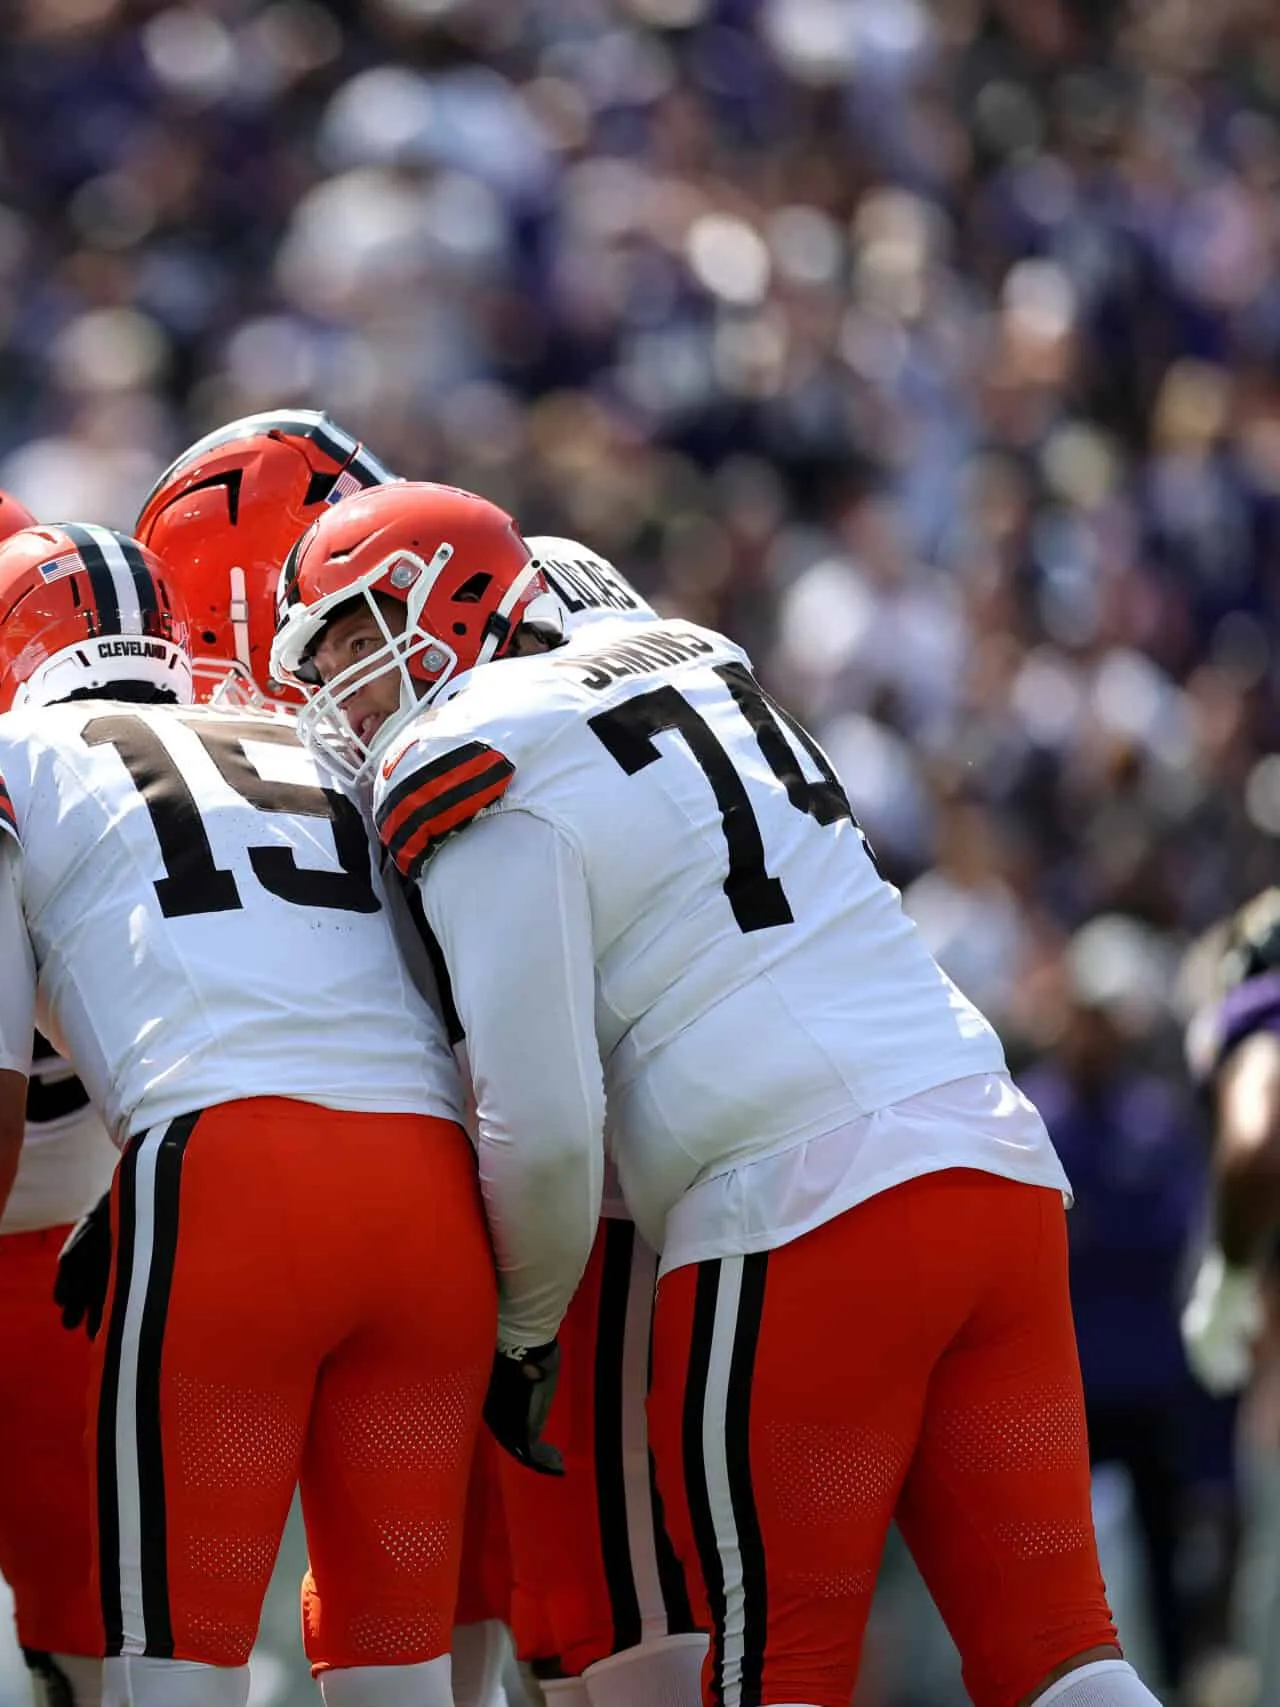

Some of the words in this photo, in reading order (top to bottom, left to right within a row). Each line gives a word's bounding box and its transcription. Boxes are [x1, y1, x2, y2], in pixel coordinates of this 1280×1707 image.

[540, 559, 639, 614] LUCAS
[97, 641, 167, 660] CLEVELAND
[552, 630, 714, 690] JENKINS
[80, 714, 382, 919] 15
[587, 661, 880, 934] 74
